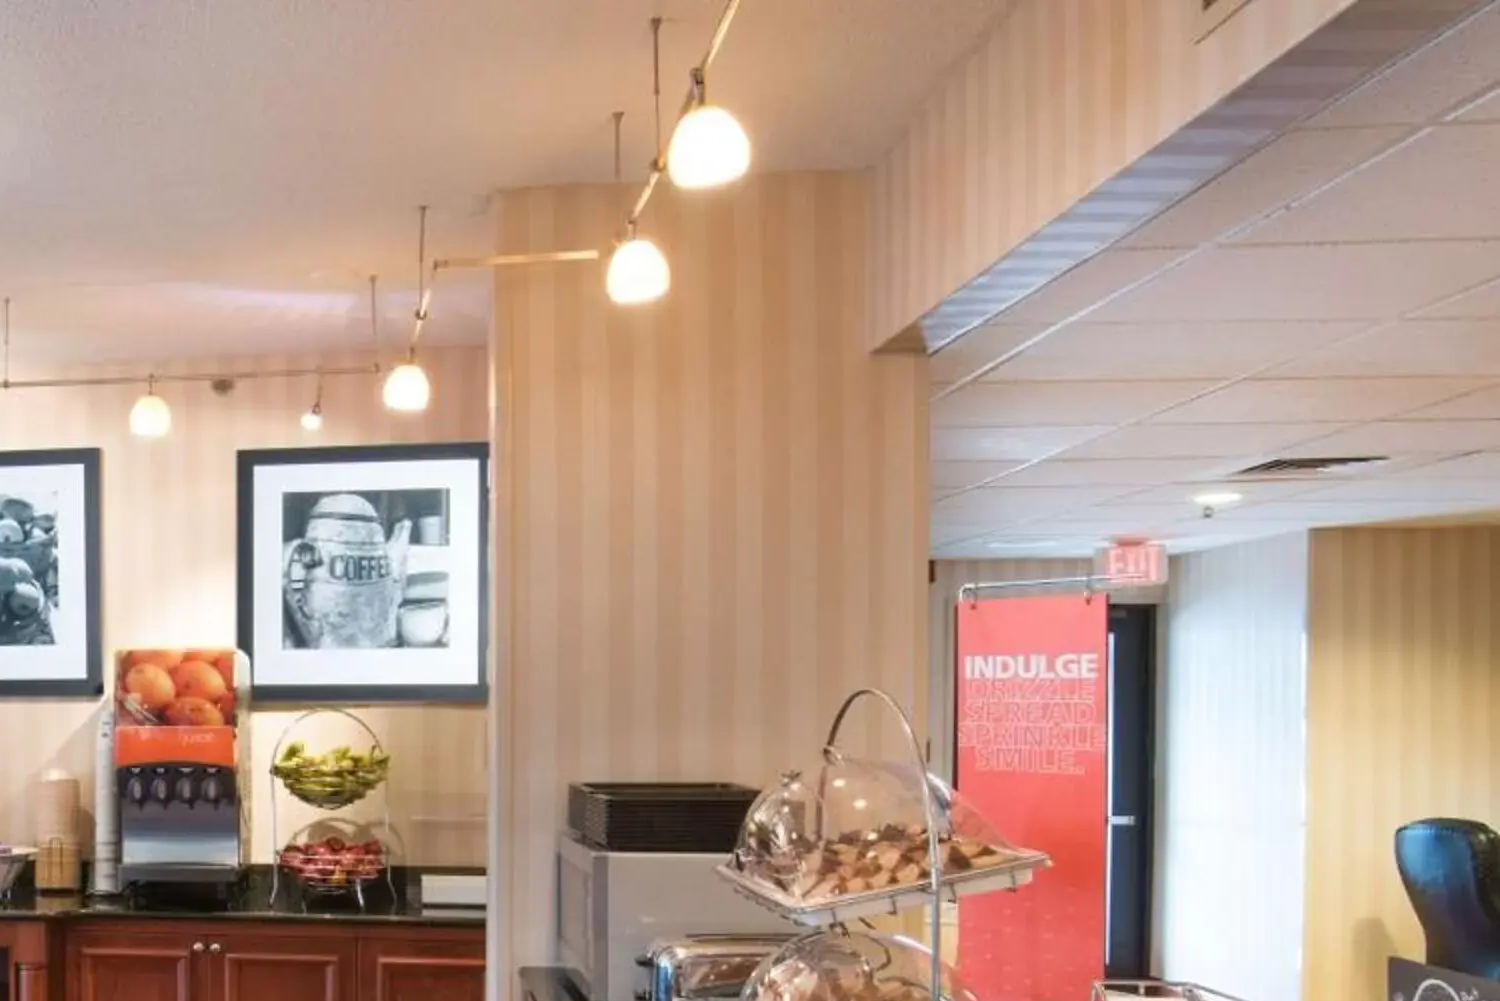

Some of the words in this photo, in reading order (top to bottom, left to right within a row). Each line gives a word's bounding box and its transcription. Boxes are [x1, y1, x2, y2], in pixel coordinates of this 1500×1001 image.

[1109, 547, 1158, 581] EXIT
[964, 653, 1099, 679] INDULGE
[964, 700, 1097, 724] SPREAD
